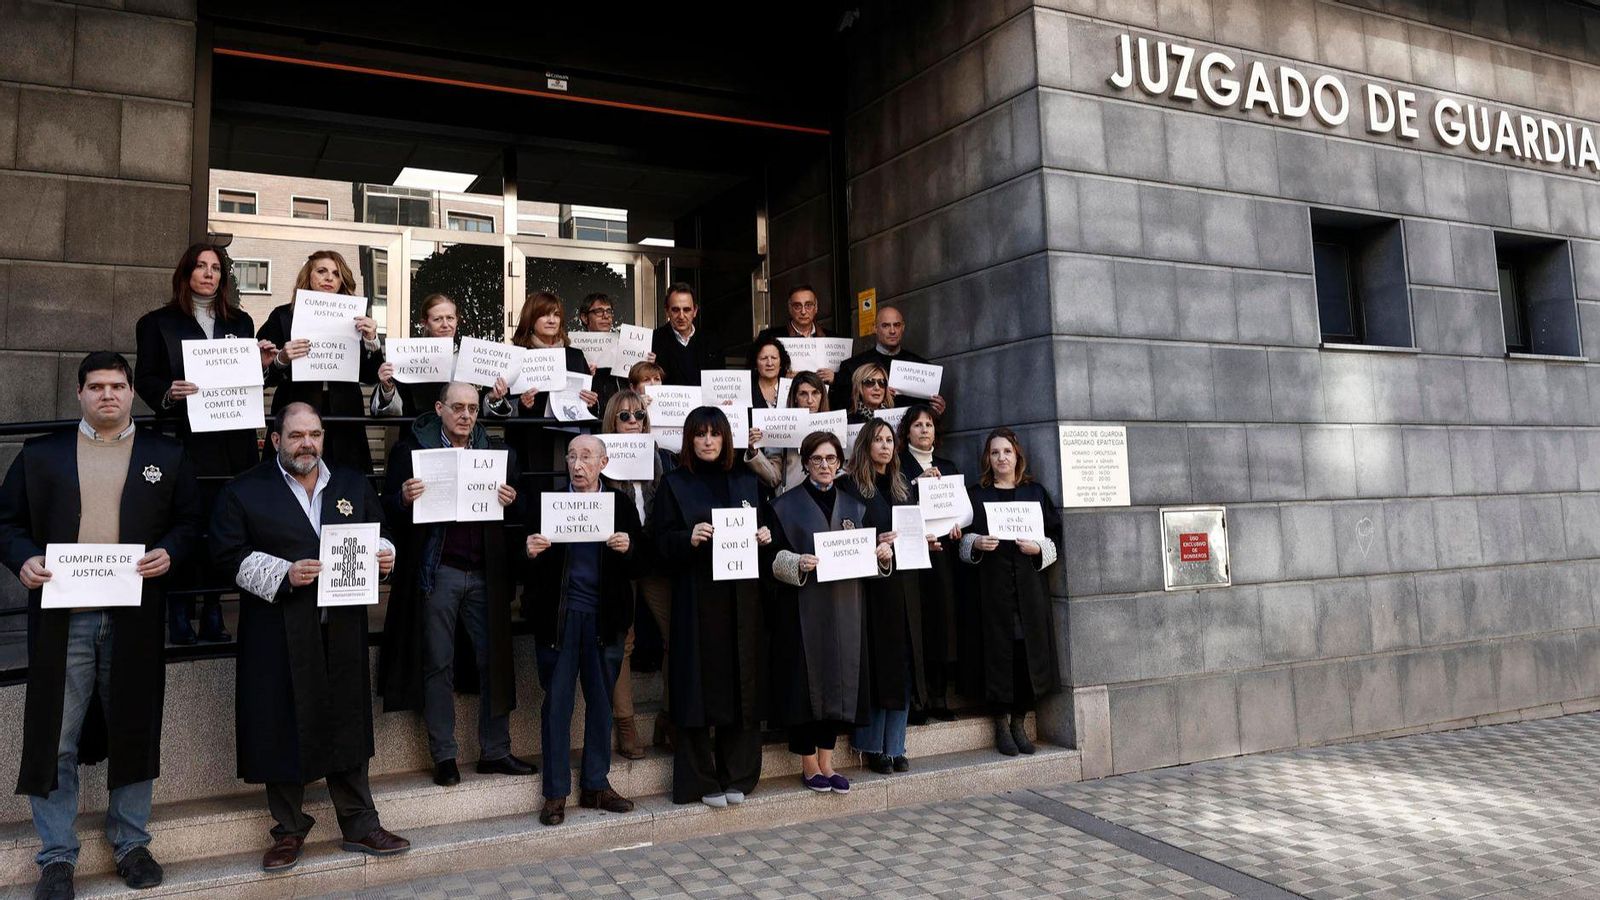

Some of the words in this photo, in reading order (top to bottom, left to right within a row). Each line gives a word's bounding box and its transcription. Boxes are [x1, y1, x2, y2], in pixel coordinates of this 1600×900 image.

[1108, 34, 1350, 127] JUZGADO
[1364, 83, 1420, 140] DE
[1432, 98, 1600, 171] GUARDIA
[304, 298, 336, 308] CUMPLIR
[630, 332, 644, 341] LAJ
[192, 347, 228, 356] CUMPLIR
[473, 357, 498, 367] COMITÉ
[202, 390, 219, 398] LAJS
[204, 400, 235, 409] COMITÉ
[473, 458, 494, 469] LAJ
[488, 481, 497, 490] el
[472, 502, 488, 512] CH
[552, 501, 602, 510] CUMPLIR:
[578, 514, 589, 522] de
[725, 517, 744, 527] LAJ
[555, 525, 600, 533] JUSTICIA
[344, 537, 357, 546] POR
[721, 542, 738, 550] con
[740, 540, 749, 549] el
[822, 539, 851, 548] CUMPLIR
[58, 555, 103, 564] CUMPLIR
[120, 555, 132, 563] DE
[343, 553, 356, 562] POR
[727, 560, 743, 571] CH
[72, 569, 116, 577] JUSTICIA.
[342, 570, 356, 579] POR
[331, 578, 366, 588] IGUALDAD
